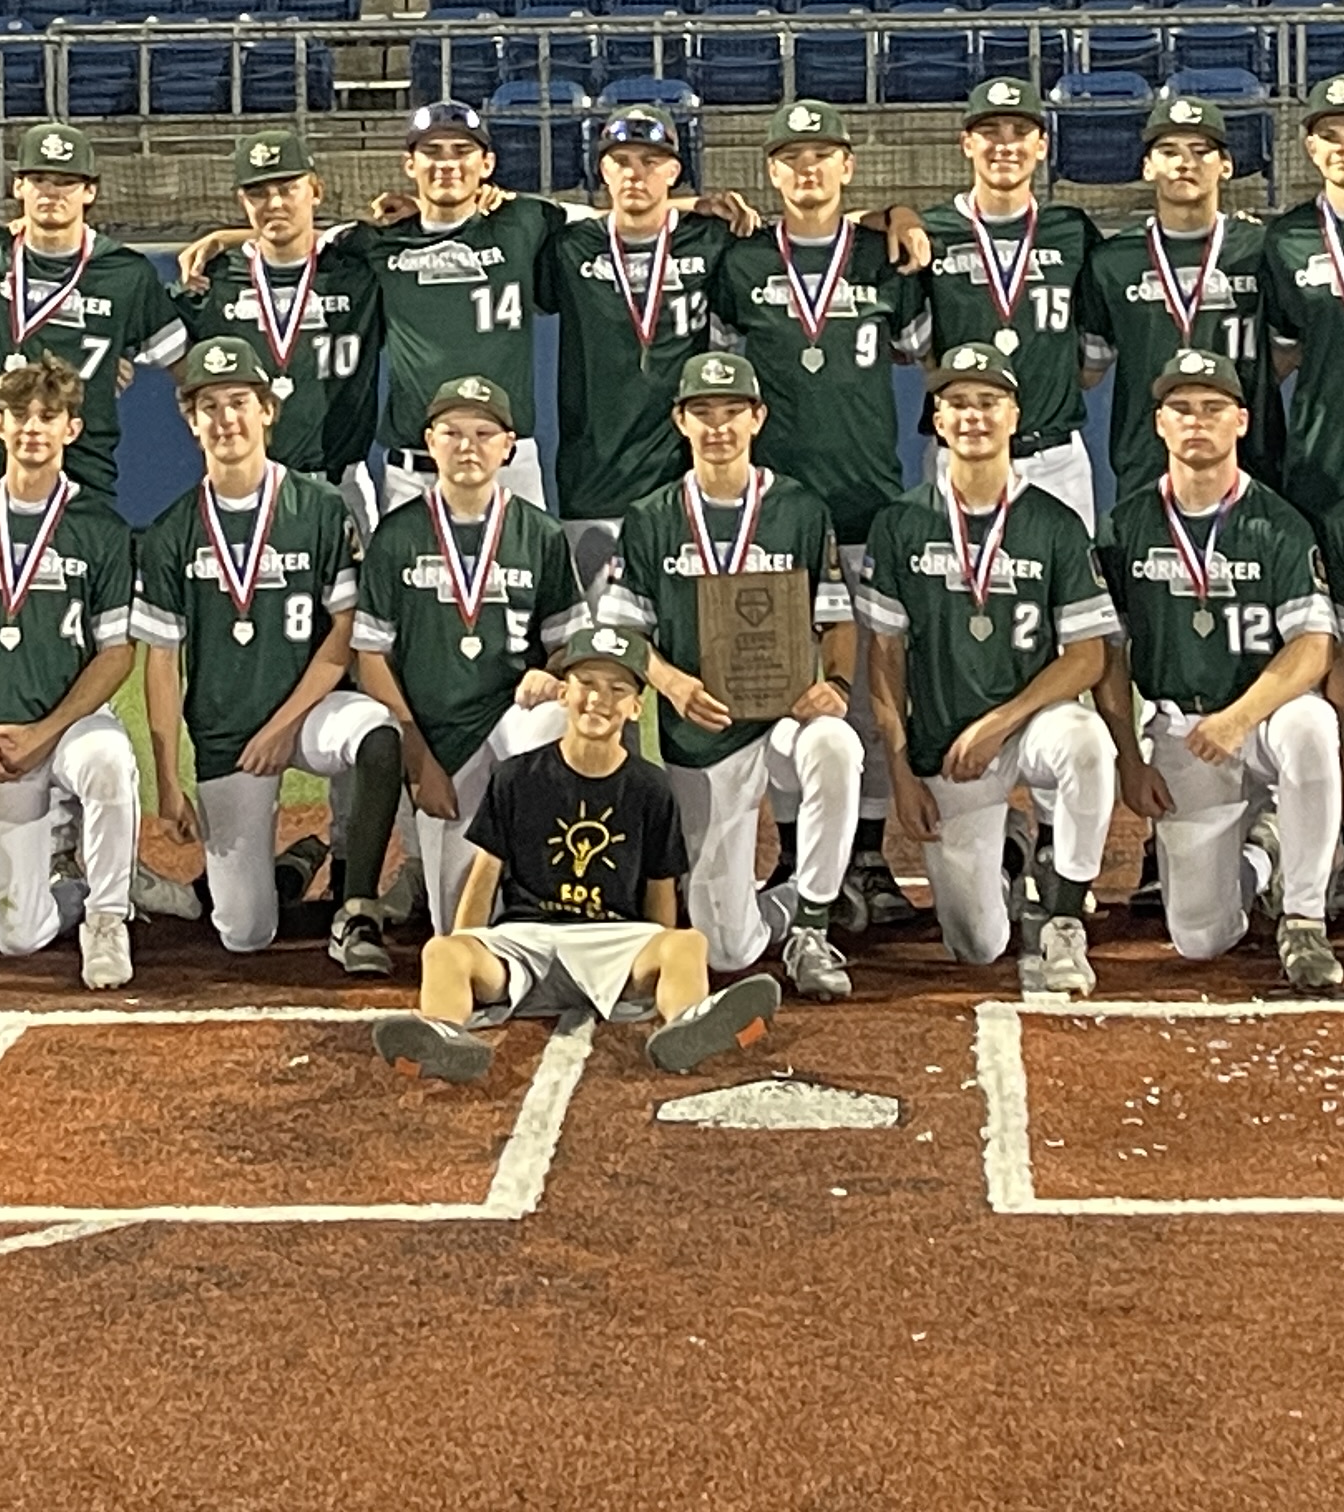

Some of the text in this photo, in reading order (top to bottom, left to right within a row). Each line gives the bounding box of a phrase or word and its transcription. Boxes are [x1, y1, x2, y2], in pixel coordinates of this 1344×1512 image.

[470, 282, 523, 333] 14
[1028, 285, 1071, 332] 15
[1125, 275, 1258, 301] CORSKER
[80, 335, 112, 380] 7
[312, 333, 360, 380] 10
[854, 322, 878, 368] 9
[1221, 315, 1258, 361] 11
[185, 552, 310, 578] CORSKER
[663, 553, 794, 575] CORSKE
[910, 553, 1043, 580] CORNSKER
[1132, 559, 1261, 580] CORNSKER
[59, 598, 85, 649] 4
[284, 592, 313, 642] 8
[504, 607, 530, 654] 5
[1012, 601, 1041, 651] 2
[1222, 602, 1271, 653] 12
